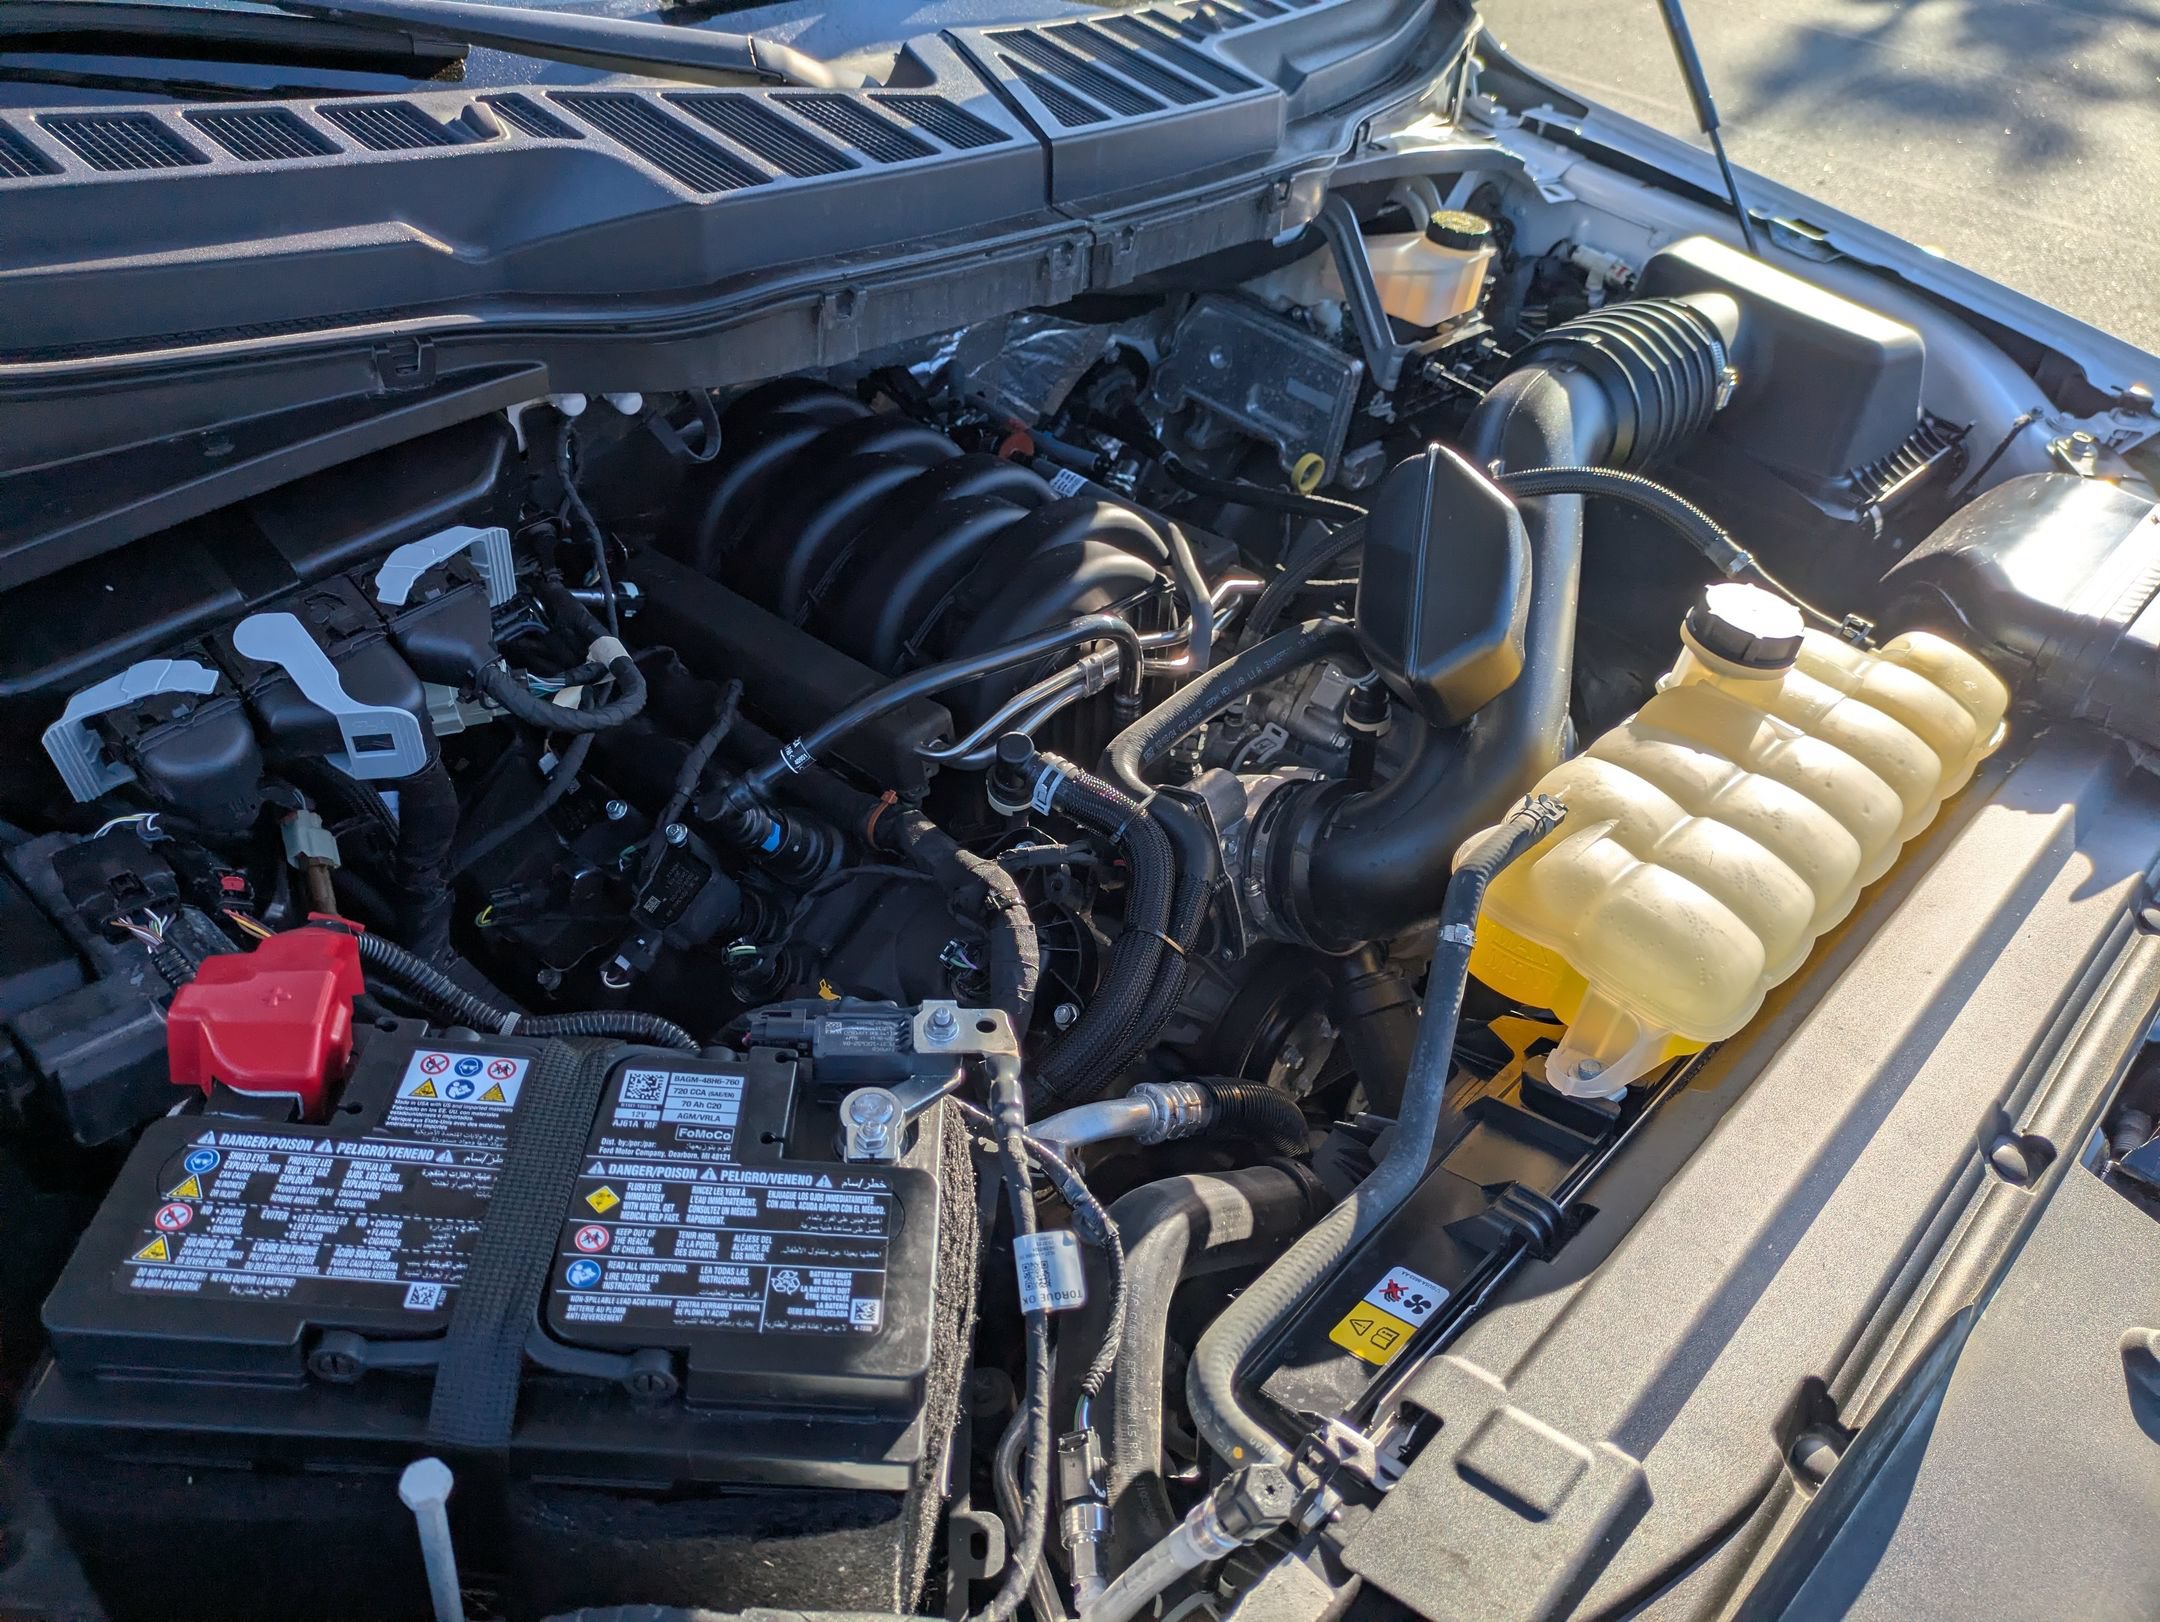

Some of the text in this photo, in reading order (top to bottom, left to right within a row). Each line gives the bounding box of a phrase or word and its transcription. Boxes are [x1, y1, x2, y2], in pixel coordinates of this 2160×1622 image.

[675, 1075, 740, 1085] BAGM-48H6-760
[677, 1114, 720, 1122] AGM/VRLA
[679, 1128, 731, 1140] FoMoCo
[219, 1133, 314, 1151] DANGER/POISON
[336, 1142, 434, 1160] PELIGRO/VENENO
[599, 1146, 611, 1154] Ford
[229, 1152, 251, 1161] SHIELD
[224, 1161, 281, 1173] EXPLOSIVE GASES
[322, 1158, 333, 1167] LES
[351, 1161, 392, 1172] PROTEJA LOS
[219, 1170, 251, 1180] CAN CAUSE
[303, 1166, 315, 1175] LES
[316, 1168, 330, 1177] GAZ
[608, 1164, 698, 1179] DANGER/POISON
[279, 1174, 314, 1184] EXPLOSIFS
[365, 1172, 378, 1180] LOS
[380, 1173, 400, 1182] GASES
[721, 1170, 813, 1186] PELIGRO/VENENO
[342, 1179, 403, 1192] EXPLOSIVOS PUEDEN
[627, 1182, 662, 1192] FLUSH EYES
[692, 1186, 712, 1194] RINCEZ
[714, 1187, 724, 1195] LES
[725, 1187, 741, 1196] YEUX
[768, 1190, 797, 1199] ENJUAGUE
[798, 1192, 809, 1200] LOS
[810, 1192, 824, 1201] OJOS
[625, 1192, 665, 1202] IMMEDIATELY
[200, 1205, 246, 1216] NO SPARKS
[623, 1201, 638, 1210] WITH
[663, 1204, 675, 1212] GET
[688, 1205, 720, 1214] CONSULTEZ
[721, 1207, 730, 1215] UN
[798, 1203, 817, 1211] ACUDA
[819, 1202, 840, 1212] RÁPIDO
[841, 1204, 853, 1213] CON
[854, 1205, 860, 1213] EL
[216, 1217, 242, 1226] FLAMES
[297, 1214, 310, 1223] LES
[311, 1214, 349, 1225] ÉTINCELLES
[620, 1212, 647, 1220] MEDICAL
[648, 1213, 663, 1221] HELP
[356, 1217, 403, 1228] NO CHISPAS
[211, 1226, 243, 1235] SMOKING
[293, 1223, 339, 1233] LES FLAMMES
[616, 1228, 656, 1237] KEEP OUT OF
[300, 1232, 323, 1241] FUMER
[371, 1229, 398, 1238] FLAMAS
[679, 1230, 715, 1241] TENIR HORS
[367, 1238, 401, 1247] CIGARROS
[628, 1237, 649, 1245] REACH
[687, 1240, 695, 1248] LA
[734, 1234, 772, 1244] ALÉJESE DEL
[611, 1246, 621, 1254] OF
[674, 1248, 687, 1257] DES
[732, 1243, 759, 1252] ALCANCE
[731, 1252, 743, 1260] LOS
[608, 1260, 625, 1270] READ
[626, 1261, 638, 1270] ALL
[700, 1266, 749, 1276] LEA TODAS LAS
[605, 1273, 660, 1283] LIRE TOUTES LES
[1022, 1289, 1082, 1305] TORQUE OK
